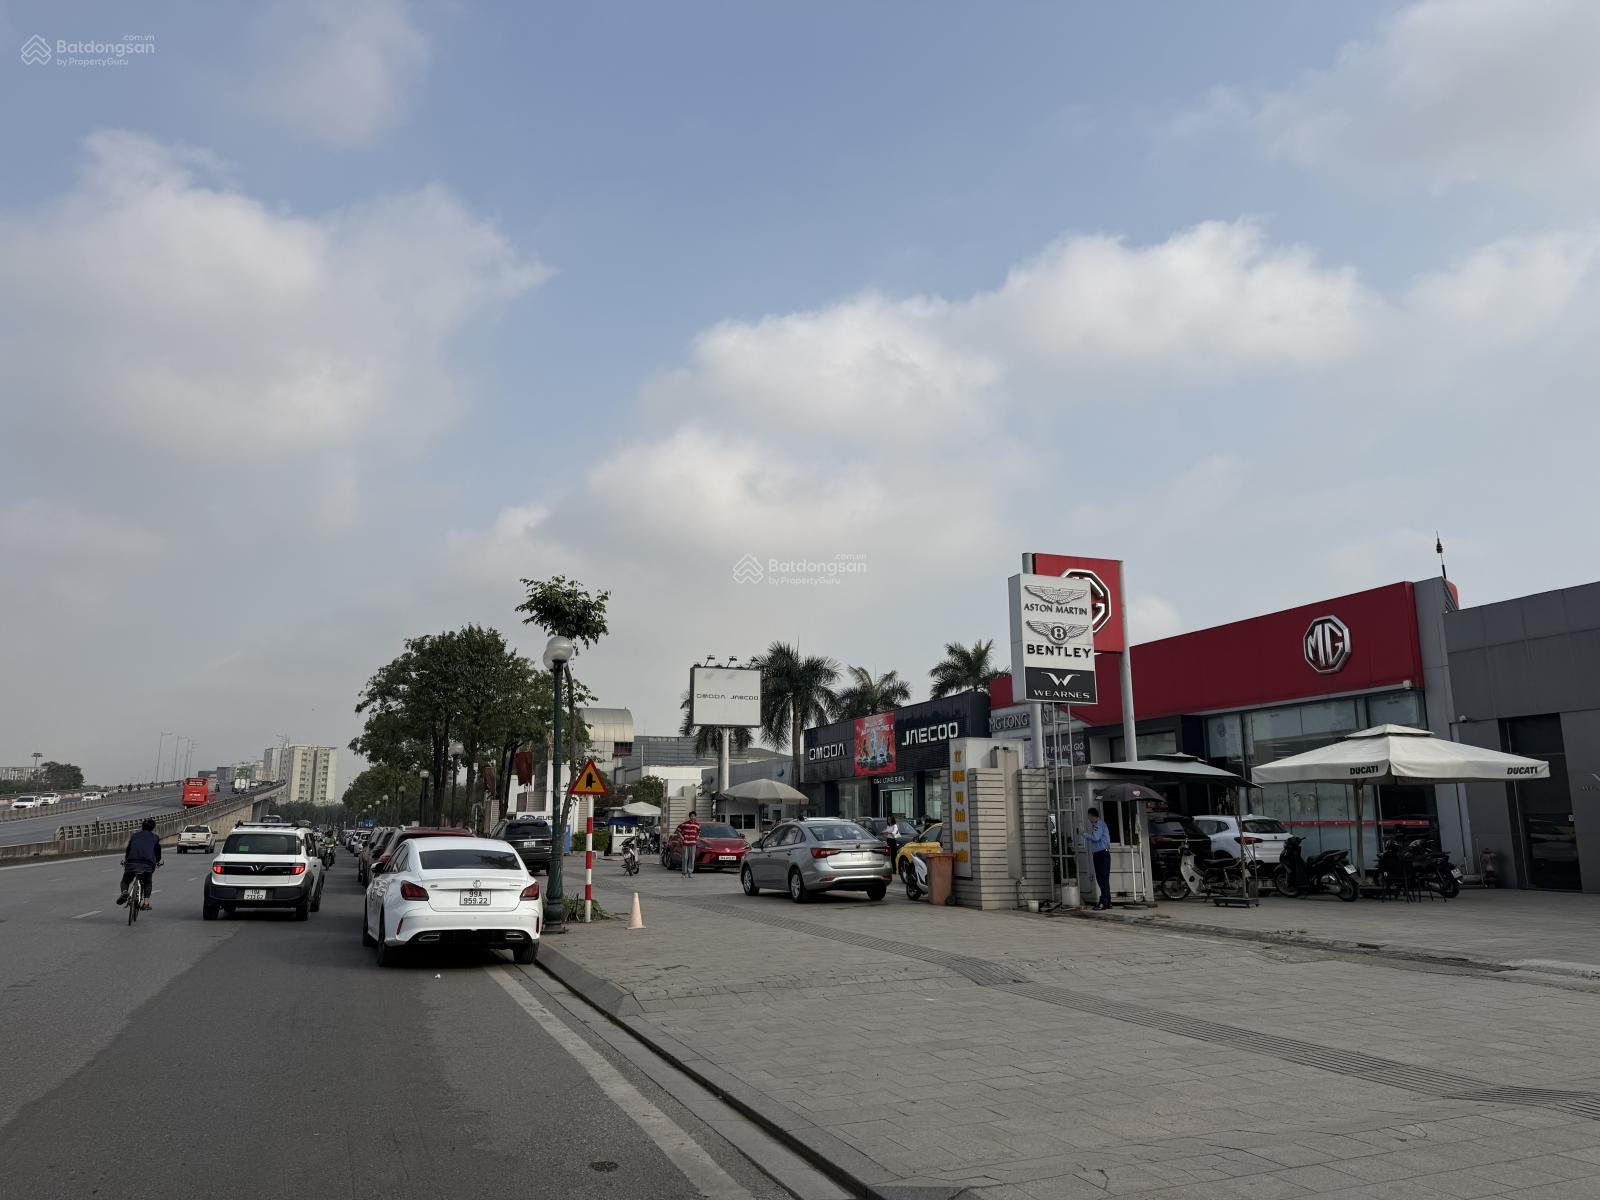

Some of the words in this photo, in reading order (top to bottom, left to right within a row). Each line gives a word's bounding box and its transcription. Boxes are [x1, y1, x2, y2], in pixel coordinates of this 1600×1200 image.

[1023, 603, 1053, 613] ASTON
[1055, 605, 1088, 616] MARTIN
[1027, 644, 1092, 658] BENTLEY
[1307, 623, 1344, 667] MG
[1033, 689, 1090, 699] WEARNES
[988, 716, 1002, 732] MG
[1003, 712, 1028, 729] LONG
[901, 721, 959, 746] JAECOO
[808, 742, 845, 761] OMODA
[1349, 765, 1379, 775] DUCATI
[1506, 766, 1538, 775] DUCATI
